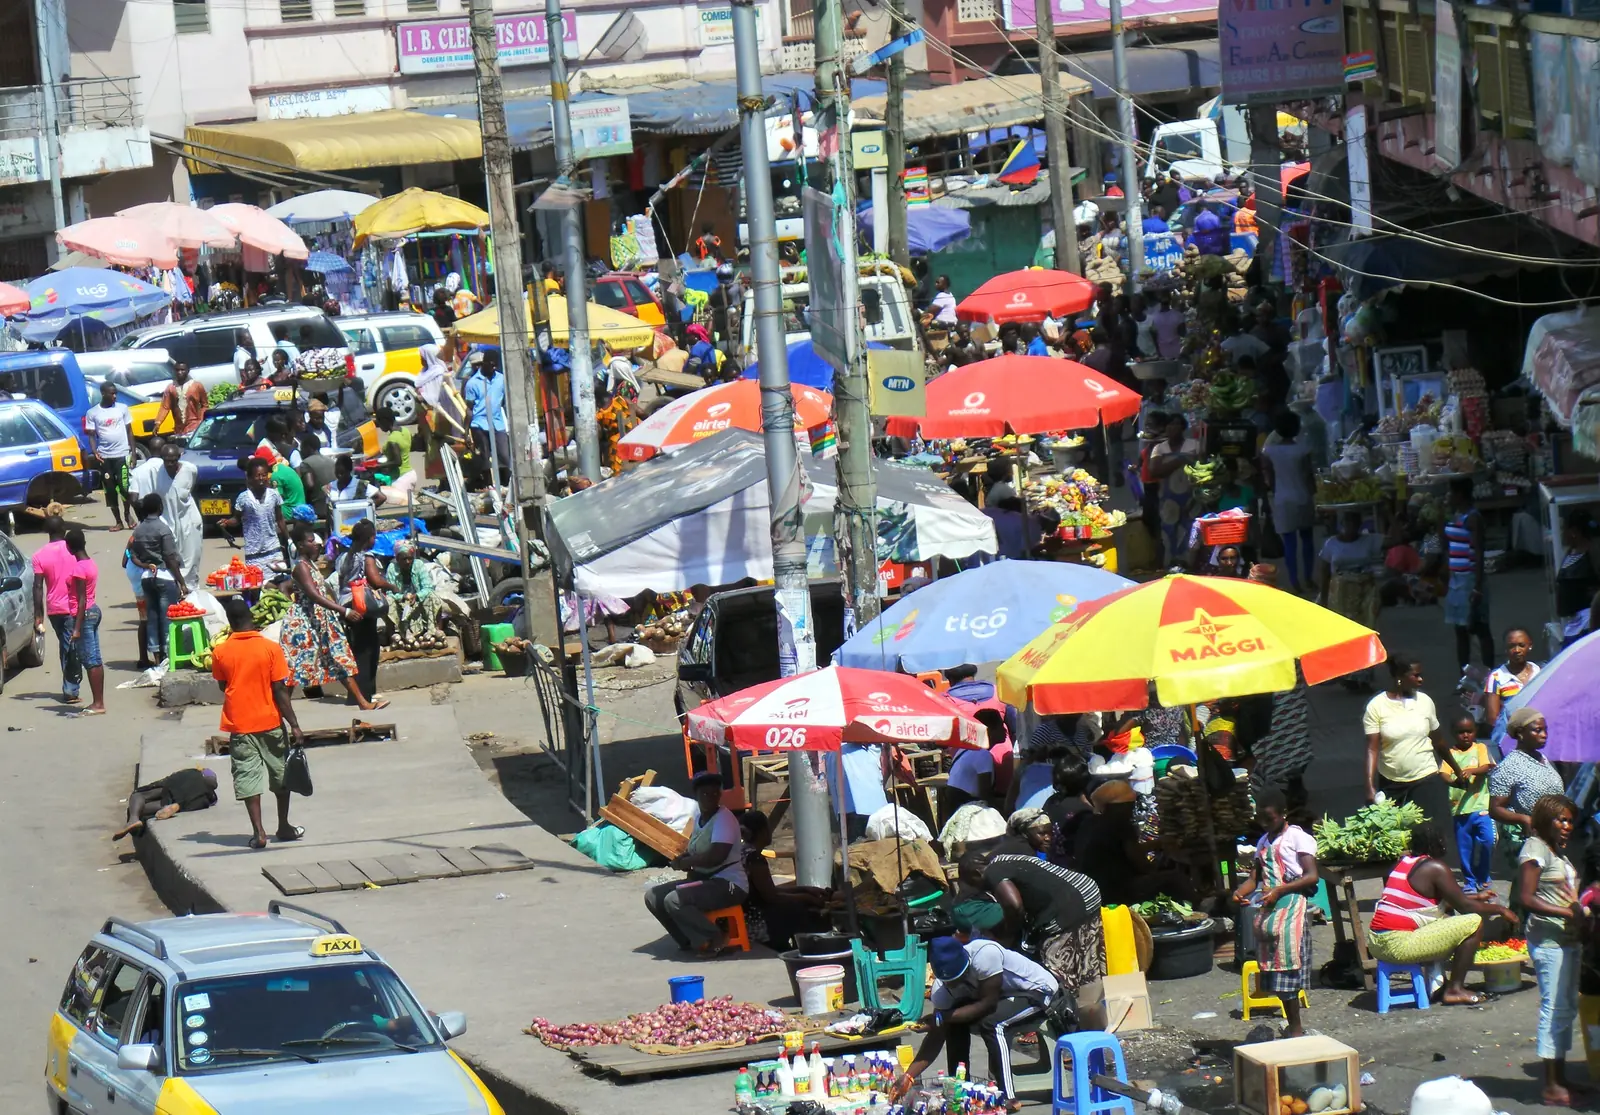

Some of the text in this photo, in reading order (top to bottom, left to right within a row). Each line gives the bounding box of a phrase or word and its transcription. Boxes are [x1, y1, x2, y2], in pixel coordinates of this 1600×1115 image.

[406, 30, 418, 53] I.
[421, 29, 436, 51] B.
[438, 22, 513, 50] CLETS
[518, 20, 540, 43] CO.
[76, 283, 109, 298] tigo
[887, 377, 910, 389] MTN
[693, 418, 731, 431] airtel
[944, 606, 1009, 639] tigo
[1169, 637, 1266, 663] MAGGI
[765, 727, 806, 748] 026
[896, 723, 931, 737] airtel
[321, 939, 358, 952] TAXI
